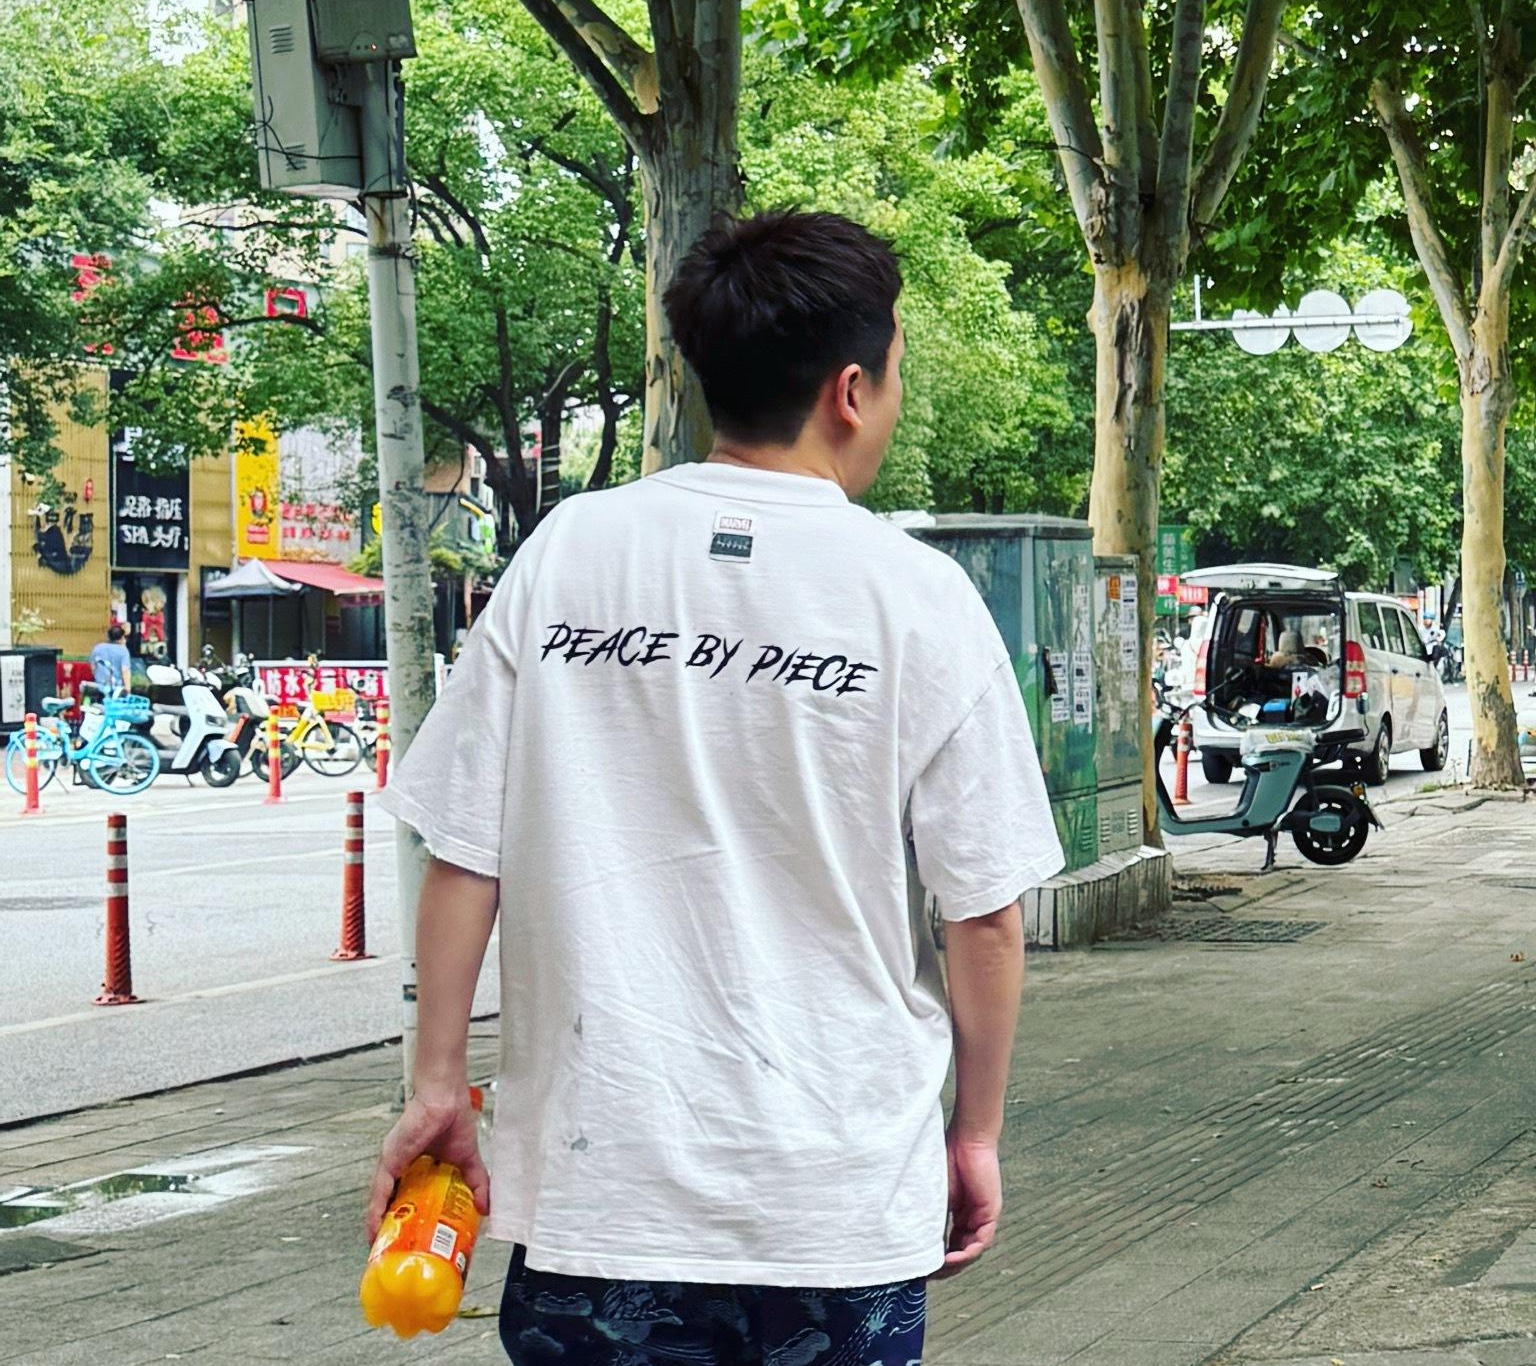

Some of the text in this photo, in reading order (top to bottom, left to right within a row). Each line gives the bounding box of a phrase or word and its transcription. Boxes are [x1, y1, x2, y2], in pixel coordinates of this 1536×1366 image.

[541, 620, 879, 697] PEACE BY PIECE
